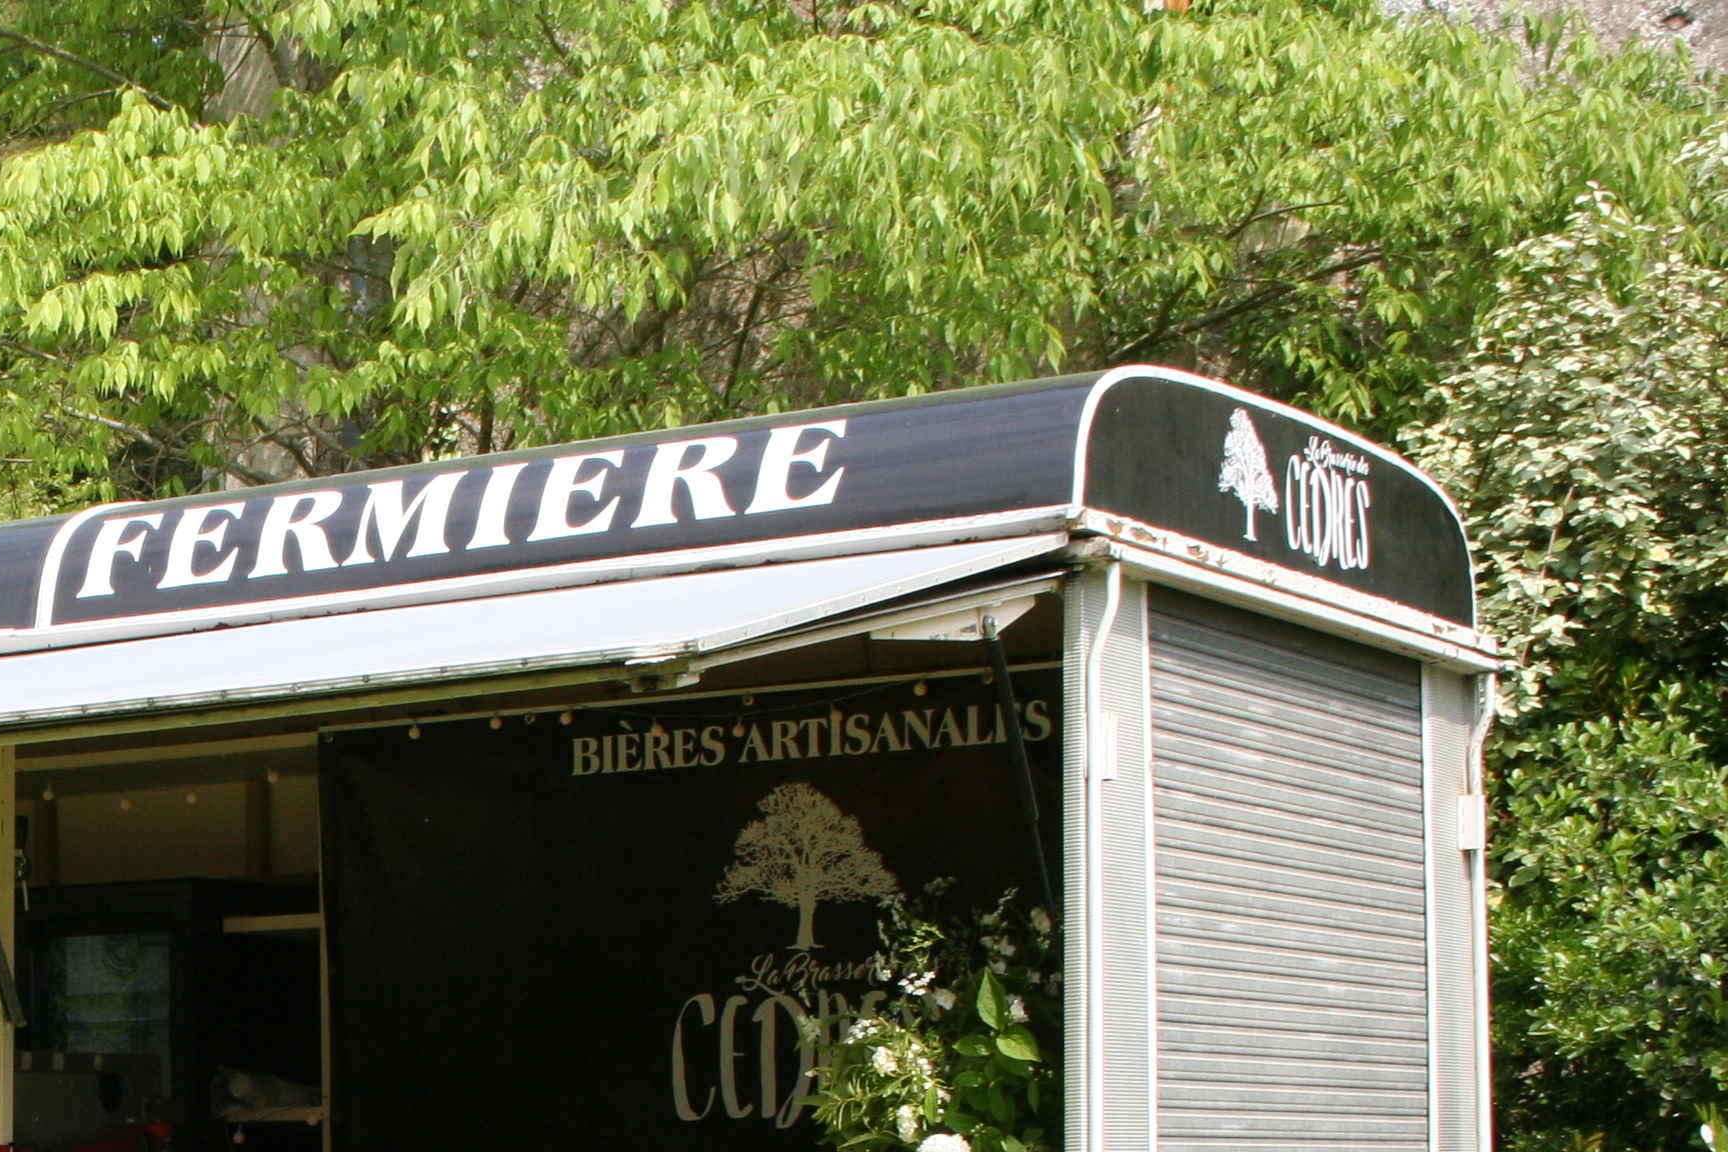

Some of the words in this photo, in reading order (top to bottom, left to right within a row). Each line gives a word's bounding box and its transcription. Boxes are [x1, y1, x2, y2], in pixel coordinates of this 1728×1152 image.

[77, 418, 848, 598] FERMIERE
[1285, 455, 1370, 570] CEDRES
[571, 718, 726, 776] BIÈRES
